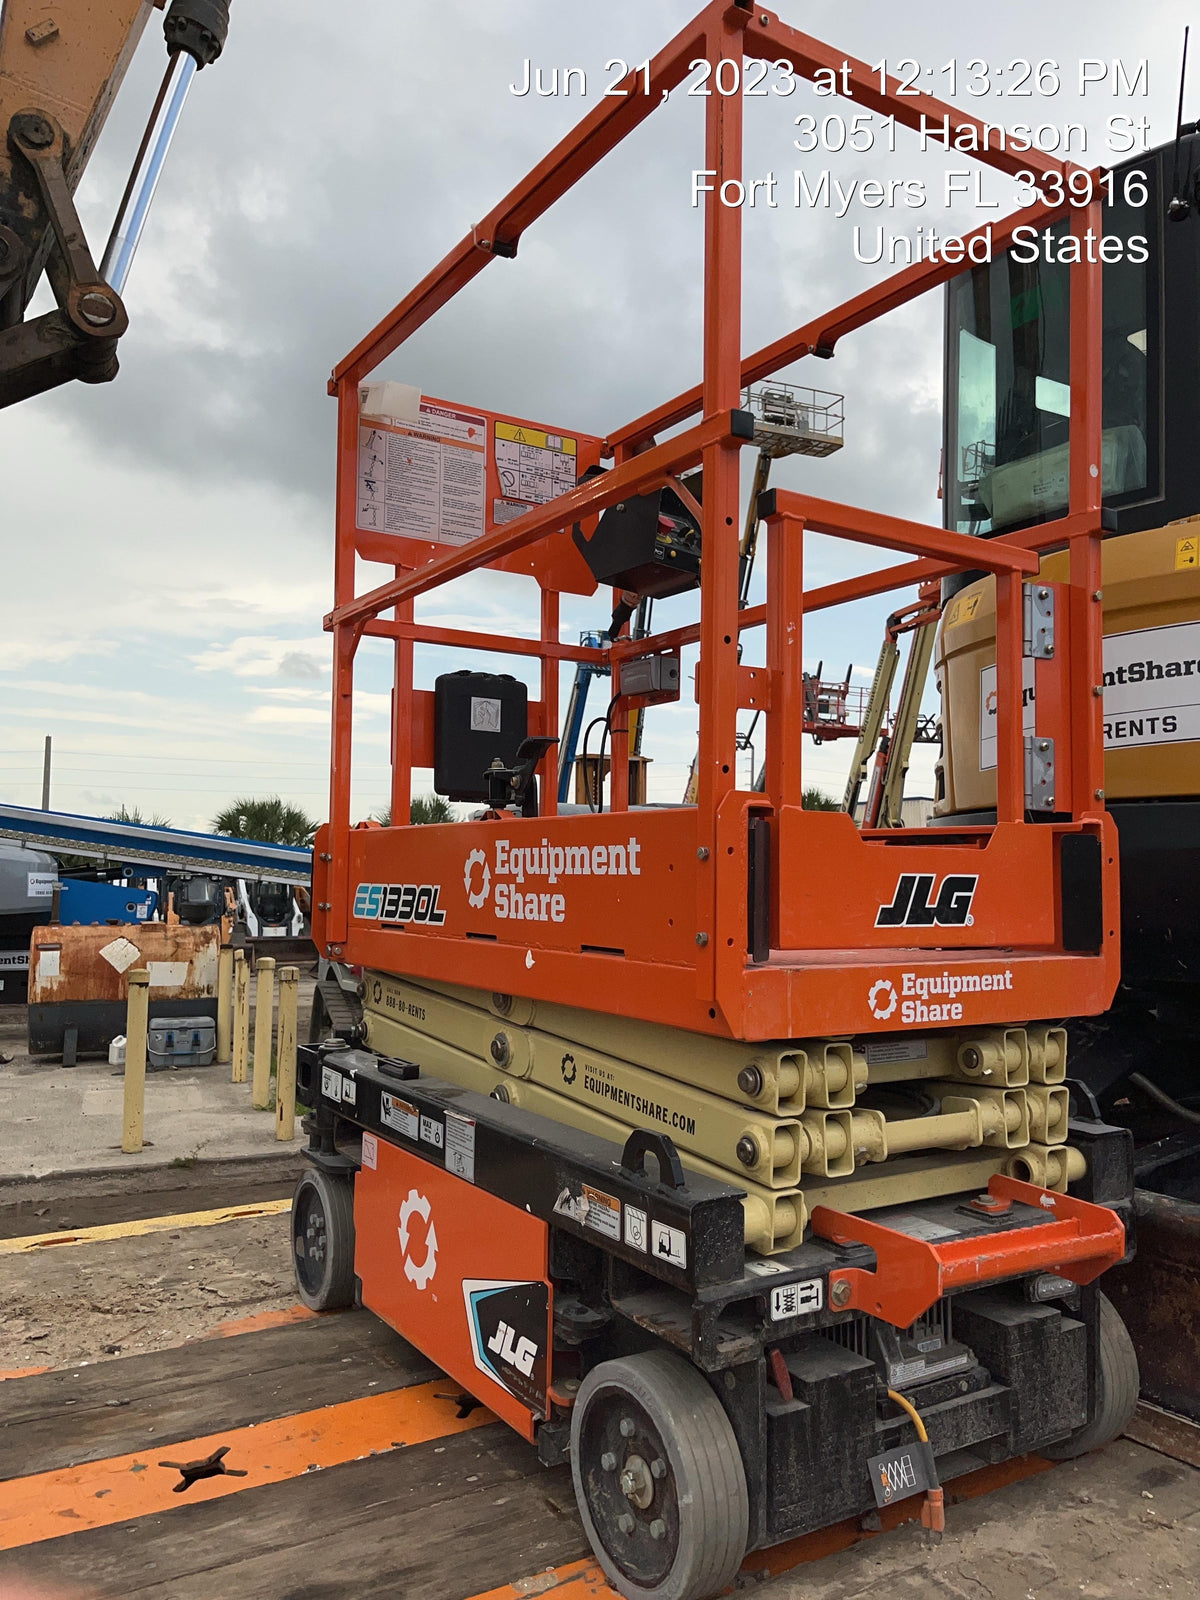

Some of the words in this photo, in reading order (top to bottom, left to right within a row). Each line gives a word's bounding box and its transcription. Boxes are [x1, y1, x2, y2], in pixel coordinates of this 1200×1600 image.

[431, 408, 457, 419] DANGER
[413, 432, 440, 442] WARNING
[495, 837, 641, 884] Equipment
[353, 883, 447, 925] ES1330L
[495, 884, 565, 922] Share
[874, 873, 979, 928] JLG
[901, 970, 1013, 999] Equipment
[901, 1001, 963, 1024] Share
[584, 1064, 598, 1075] VISIT
[599, 1070, 606, 1078] US
[607, 1073, 615, 1081] AT:
[584, 1075, 696, 1135] EQUIPMENTSHARE.COM
[487, 1320, 538, 1377] JLG
